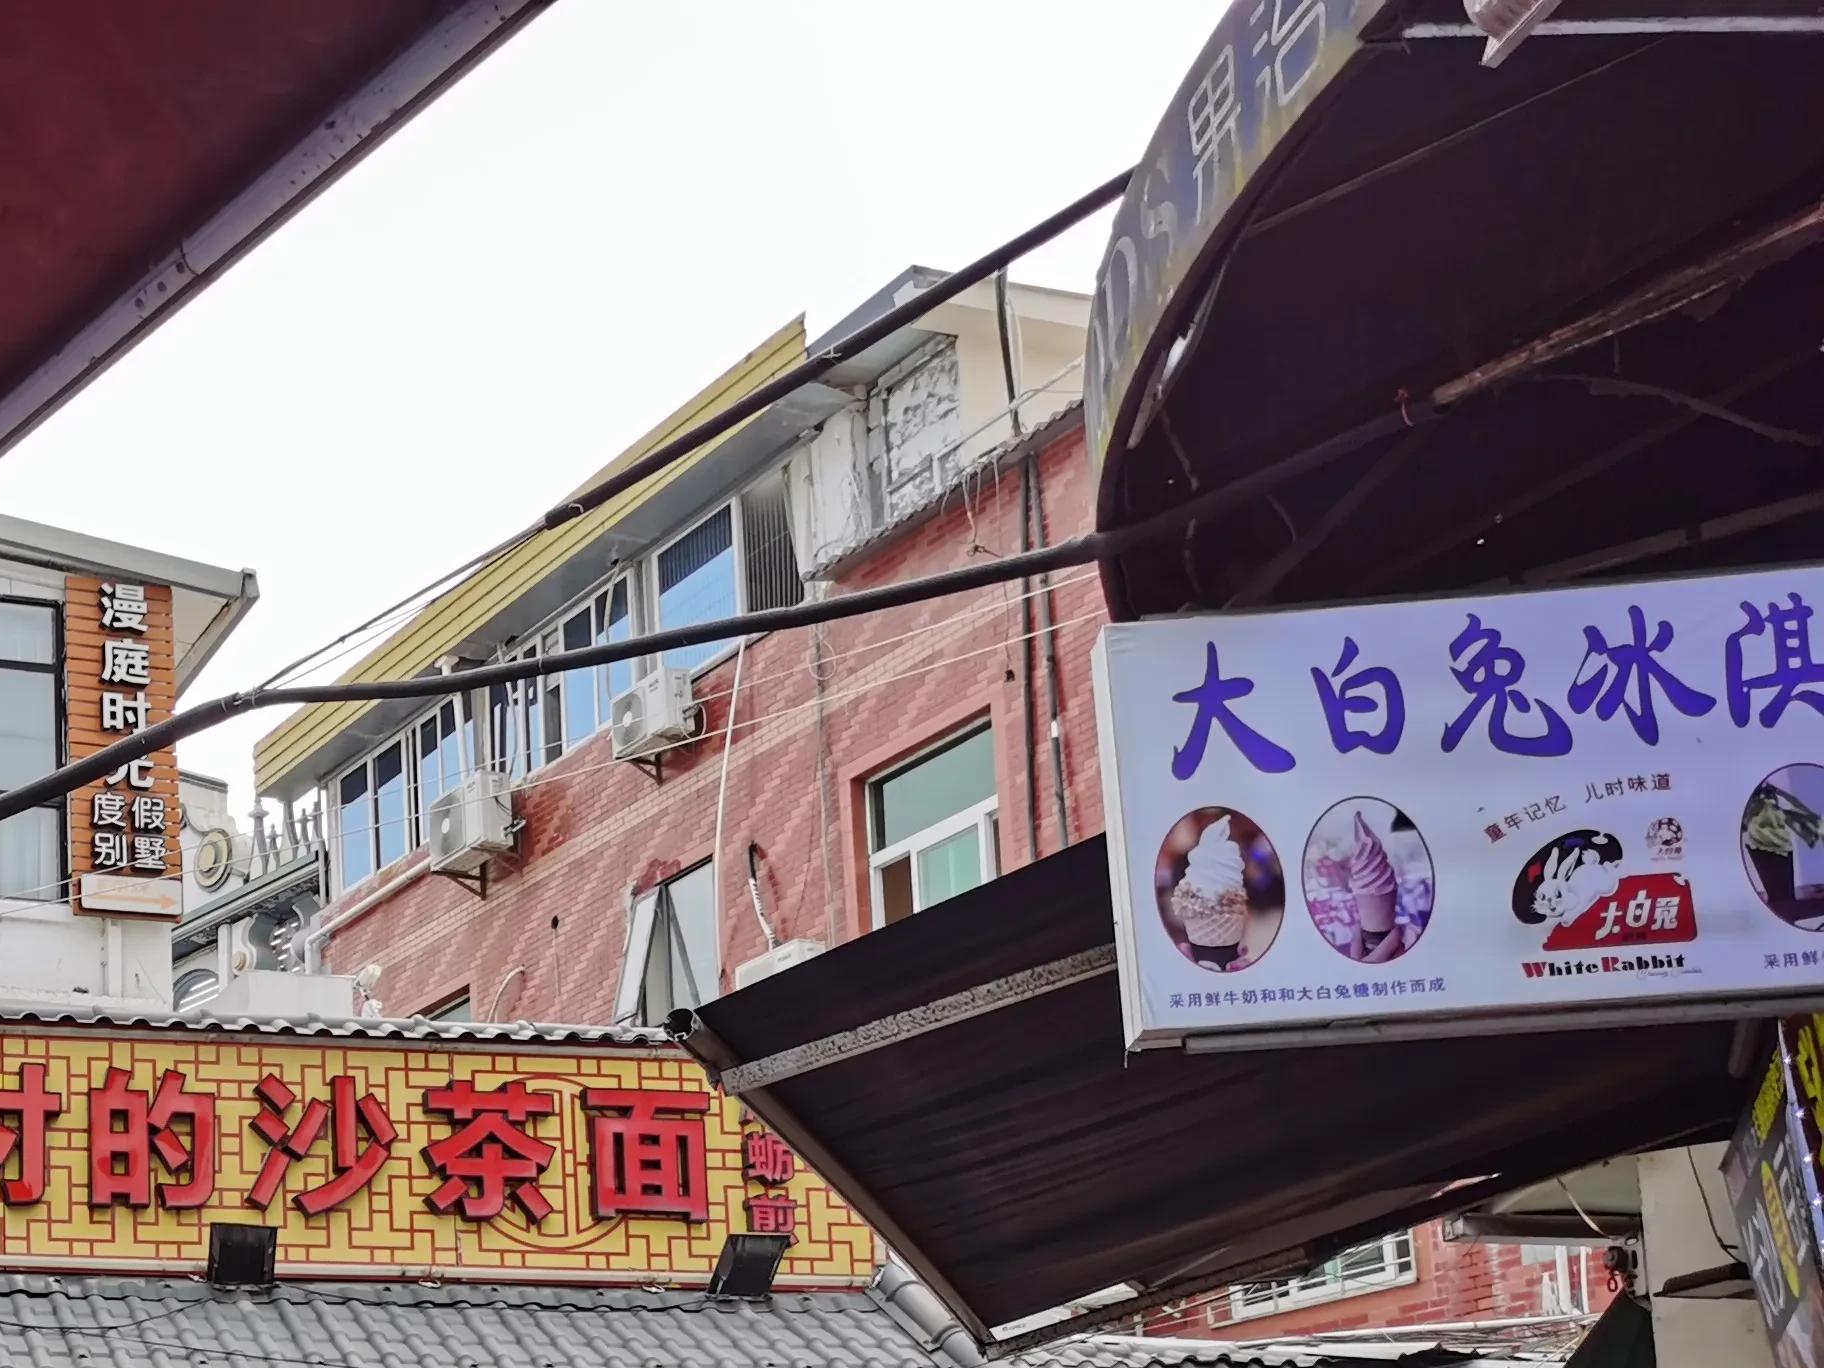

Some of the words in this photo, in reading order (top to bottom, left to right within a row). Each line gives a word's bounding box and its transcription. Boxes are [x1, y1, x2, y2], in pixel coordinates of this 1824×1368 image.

[99, 582, 155, 789] 漫庭时光
[1171, 593, 1824, 781] 大白兔冰淇
[93, 792, 166, 831] 度假
[1483, 795, 1567, 843] 童年记忆
[1584, 773, 1672, 804] 儿时味道
[94, 833, 167, 871] 别墅
[1595, 889, 1680, 940] 大白兔
[1763, 948, 1824, 970] 采用鲜
[1169, 976, 1447, 1010] 采用鲜牛奶和和大白兔糖制作而成
[739, 1105, 798, 1247] 蛎煎
